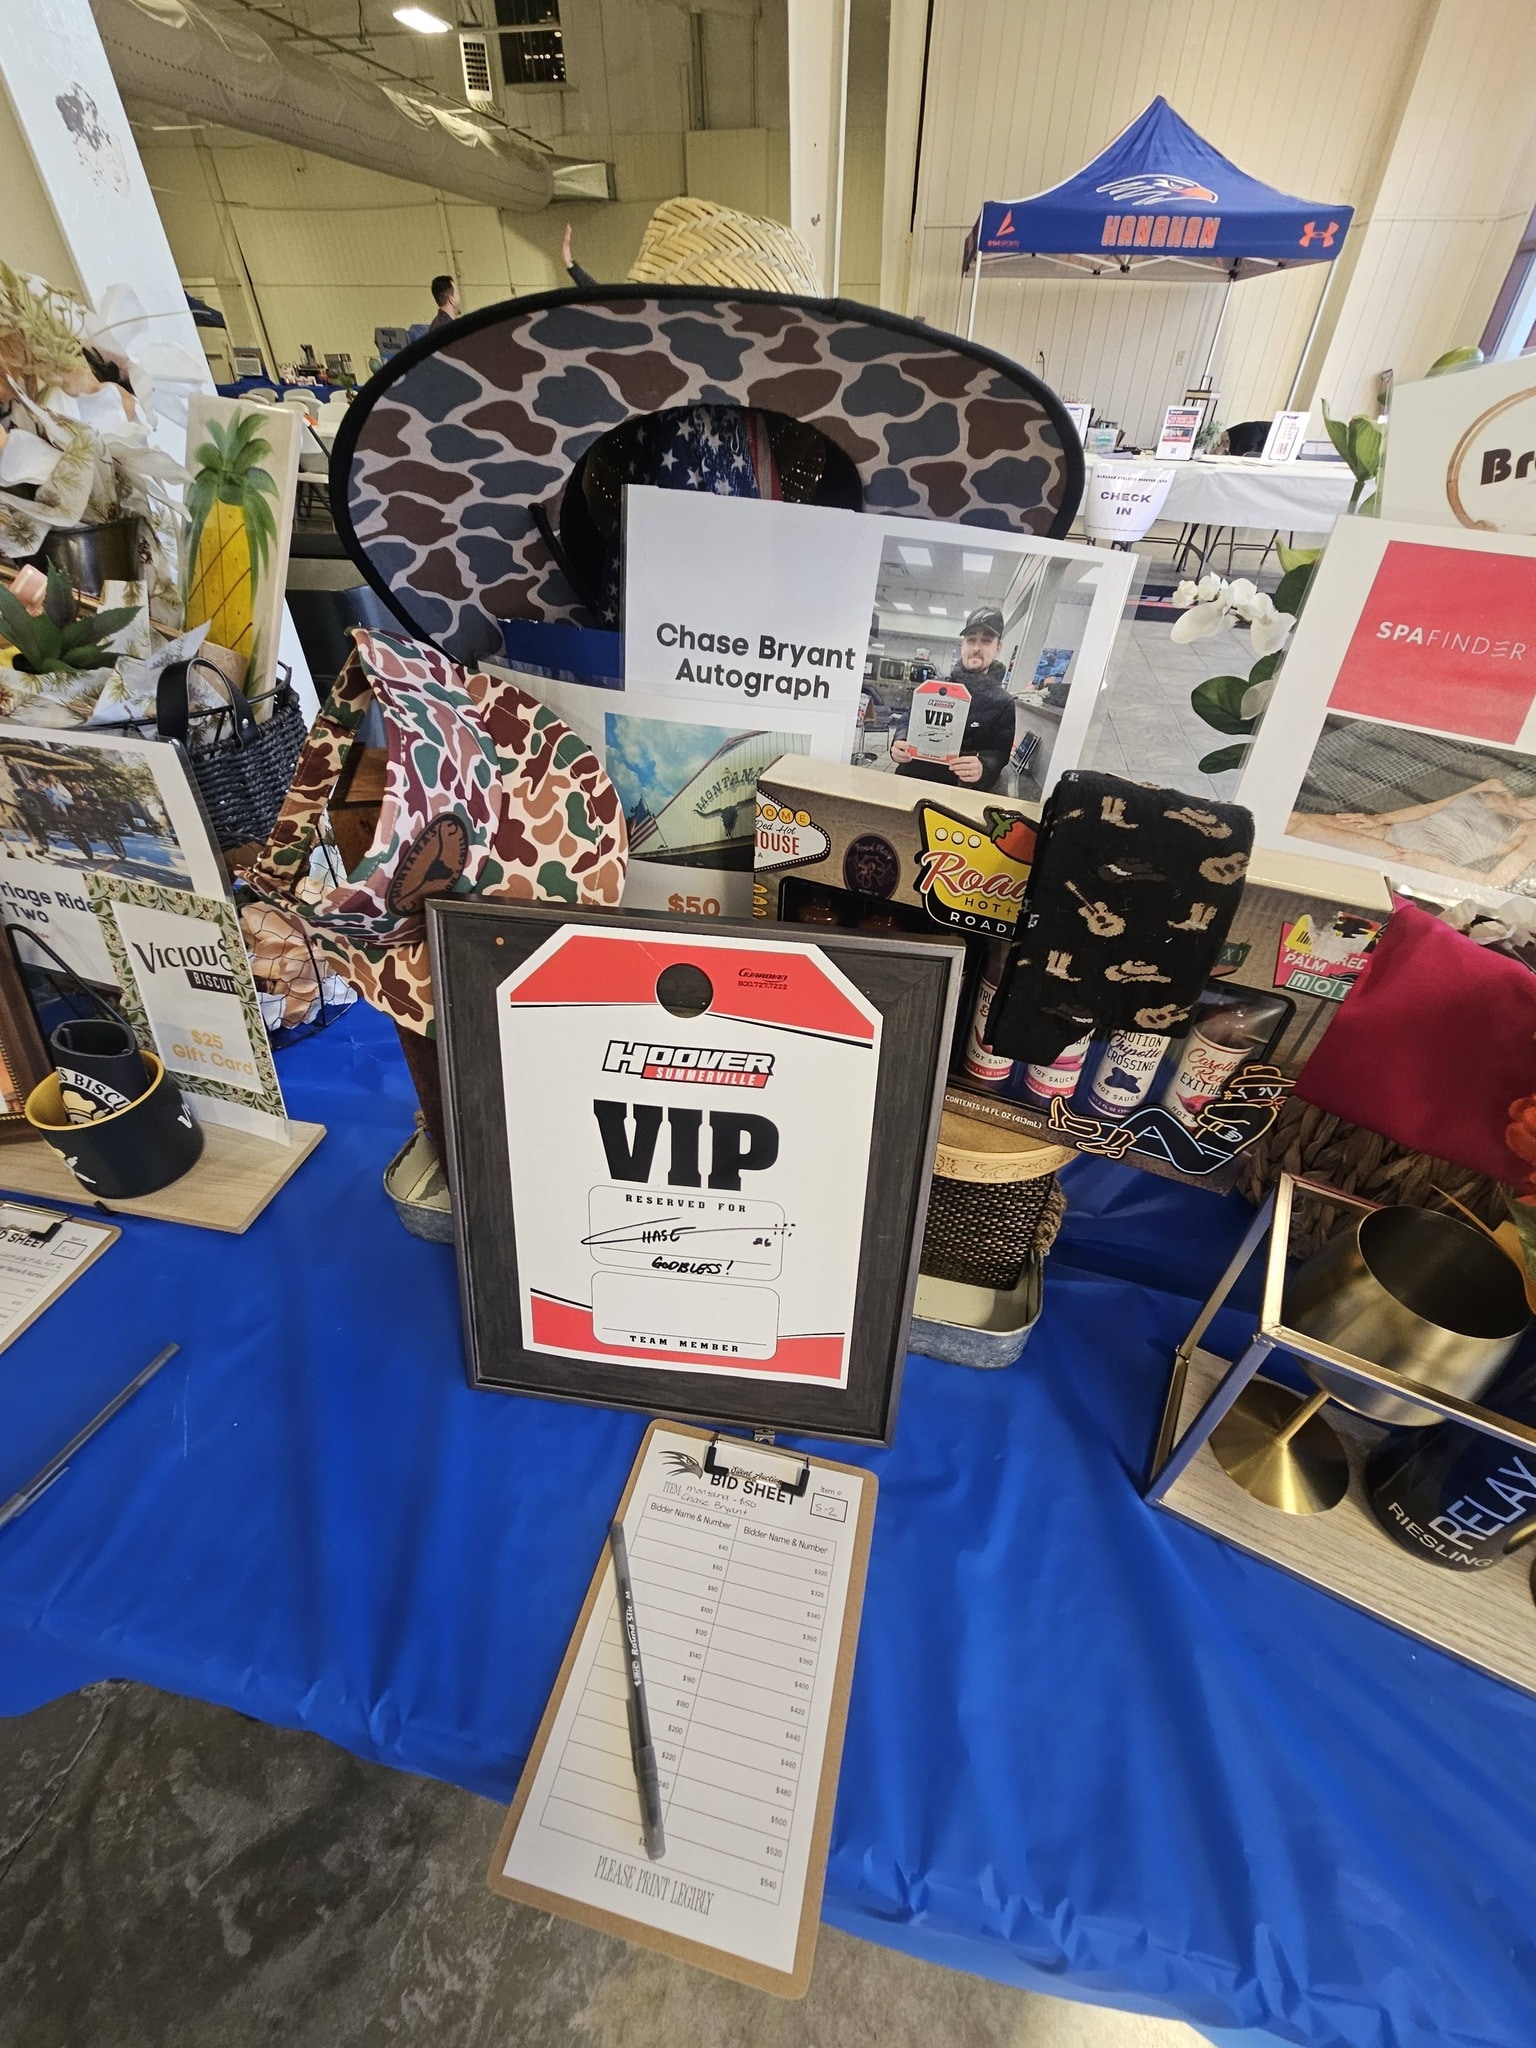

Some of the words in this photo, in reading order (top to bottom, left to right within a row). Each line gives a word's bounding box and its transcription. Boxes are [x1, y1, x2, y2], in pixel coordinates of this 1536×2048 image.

[1101, 215, 1221, 248] HANAHAN
[1480, 448, 1536, 485] Br
[1100, 491, 1152, 504] CHECK
[1116, 506, 1132, 516] IN
[656, 623, 749, 656] Chase
[758, 635, 857, 671] Bryant
[1376, 621, 1527, 661] SPAFINDER
[675, 659, 831, 699] Autograph
[925, 709, 953, 727] VIP
[6, 901, 49, 923] Two
[667, 893, 721, 916] $50
[964, 897, 1001, 913] HOT
[1283, 953, 1329, 972] PALM
[191, 1029, 224, 1050] $25
[1122, 1031, 1164, 1047] AUTION
[172, 1043, 207, 1064] Gift
[210, 1052, 254, 1076] Card
[602, 1040, 776, 1076] HOOVER
[971, 1048, 985, 1061] HOT
[1106, 1047, 1156, 1072] CROSSING
[1188, 1048, 1238, 1072] Caroli
[655, 1066, 757, 1086] SUMMERVILLE
[1033, 1065, 1046, 1078] HOT
[1048, 1076, 1075, 1084] SAUCE
[1180, 1072, 1207, 1093] EXIT
[1192, 1065, 1226, 1085] Rea
[1097, 1081, 1110, 1095] HOT
[1113, 1094, 1140, 1102] SAUCE
[944, 1094, 980, 1111] CONTENTS
[981, 1105, 990, 1114] 14
[991, 1107, 1000, 1116] FL
[1001, 1111, 1012, 1119] OZ
[1012, 1114, 1042, 1129] (413mL)
[1171, 1106, 1187, 1119] HOT
[593, 1099, 780, 1191] VIP
[625, 1194, 705, 1209] RESERVED
[718, 1203, 747, 1213] FOR
[7, 1232, 48, 1249] SHEET
[630, 1334, 669, 1346] TEAM
[679, 1340, 741, 1353] MEMBER
[730, 1465, 752, 1479] Silent
[710, 1474, 739, 1490] BID
[743, 1481, 795, 1506] SHEET
[820, 1486, 837, 1495] Item
[681, 1493, 710, 1506] Chase
[714, 1500, 748, 1515] Bryant
[1428, 1456, 1536, 1550] RELAX
[650, 1502, 674, 1514] Bidder
[675, 1508, 696, 1520] Name
[696, 1514, 702, 1522] &
[703, 1516, 732, 1529] Number
[743, 1526, 768, 1541] Bidder
[768, 1533, 790, 1546] Name
[792, 1539, 798, 1547] &
[798, 1540, 829, 1555] Number
[1388, 1502, 1494, 1567] RIESLING
[814, 1568, 828, 1577] $300
[707, 1585, 718, 1593] $80
[810, 1589, 825, 1598] $320
[626, 1605, 634, 1621] Stic
[700, 1606, 713, 1614] $100
[806, 1611, 821, 1620] $340
[628, 1623, 639, 1655] Round
[695, 1628, 708, 1637] $120
[802, 1633, 817, 1643] $360
[688, 1650, 702, 1660] $140
[794, 1680, 809, 1691] $400
[790, 1705, 805, 1716] $420
[668, 1724, 683, 1735] $200
[785, 1731, 801, 1742] $440
[661, 1751, 677, 1762] $220
[780, 1758, 797, 1770] $460
[775, 1786, 792, 1797] $480
[771, 1815, 787, 1827] $500
[766, 1846, 783, 1858] $520
[594, 1855, 637, 1889] PLEASE
[635, 1869, 670, 1900] PRINT
[670, 1880, 715, 1916] LEGIBLY
[760, 1876, 777, 1890] $540
